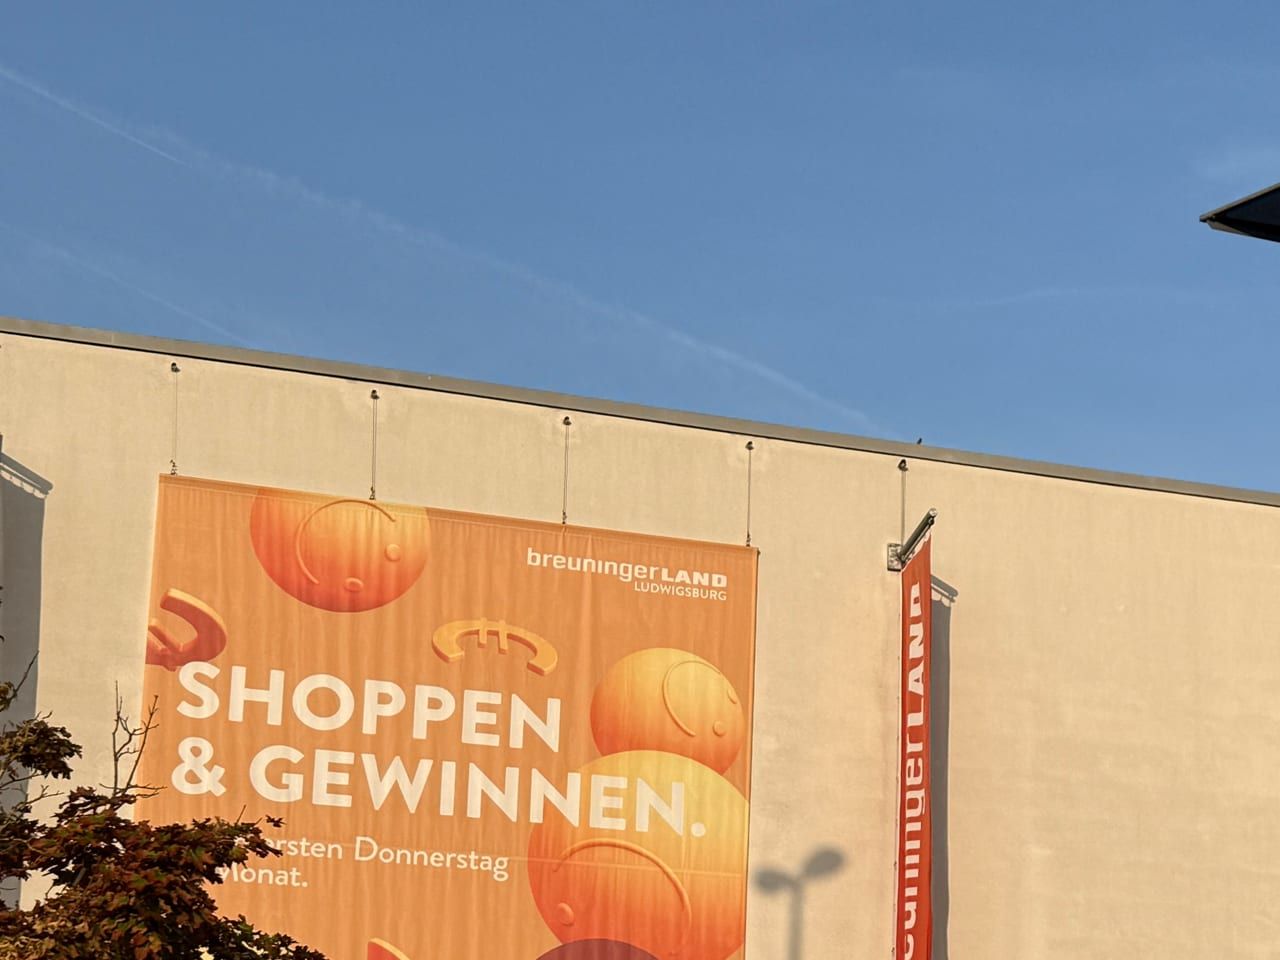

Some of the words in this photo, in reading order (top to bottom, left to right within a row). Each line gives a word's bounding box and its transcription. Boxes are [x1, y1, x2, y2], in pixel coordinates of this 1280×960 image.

[527, 547, 728, 588] breuningerLAND
[634, 581, 727, 601] LUDWIGSBURG
[176, 660, 561, 754] SHOPPEN
[170, 736, 228, 798] &
[248, 744, 707, 837] GEWINNEN.
[354, 836, 509, 881] Donnerstag
